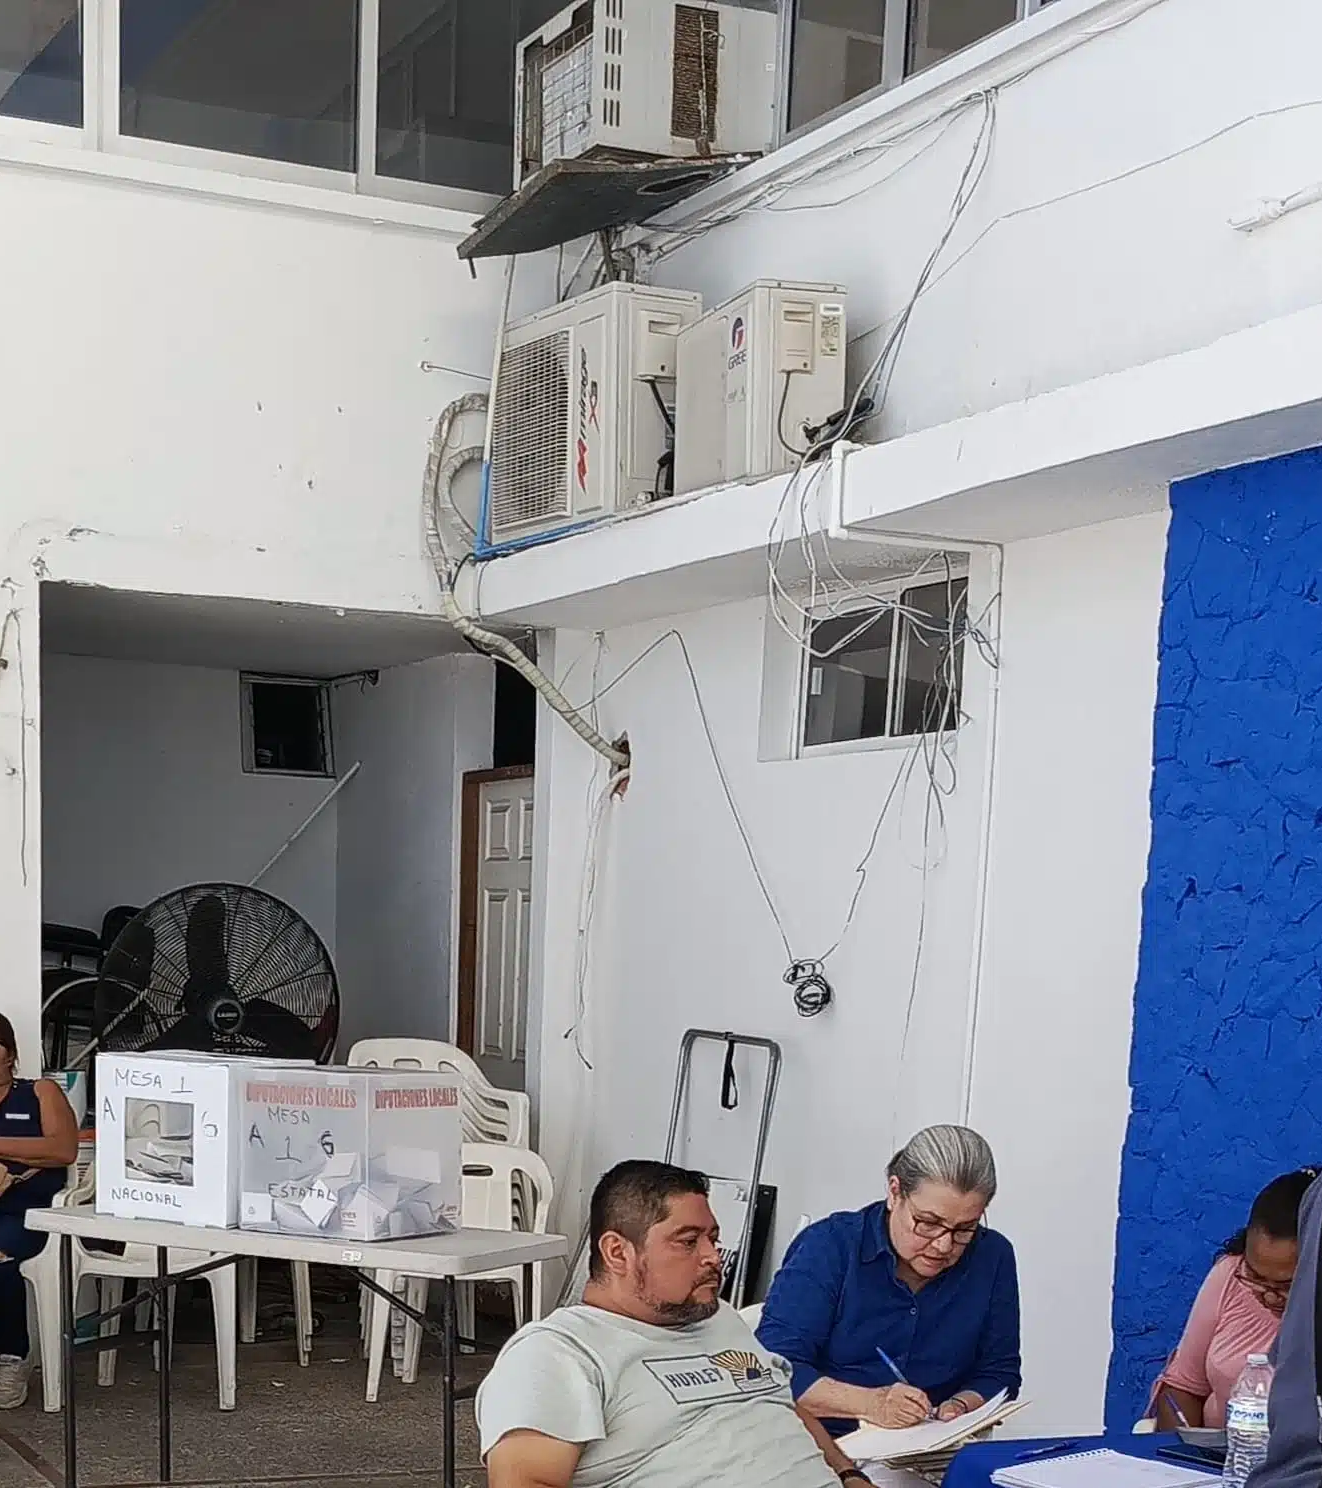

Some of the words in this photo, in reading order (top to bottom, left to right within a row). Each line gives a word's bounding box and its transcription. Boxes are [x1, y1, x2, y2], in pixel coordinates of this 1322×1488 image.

[727, 349, 749, 370] GREE
[114, 1067, 163, 1089] MESA
[170, 1076, 194, 1094] 1
[245, 1081, 314, 1105] DIPUTACIONES
[315, 1086, 358, 1109] LOCALES
[374, 1088, 428, 1110] DIPUTACIONES
[428, 1086, 459, 1109] LOCALES
[102, 1095, 116, 1123] A
[267, 1105, 311, 1125] MESA
[248, 1122, 265, 1148] A
[275, 1135, 303, 1163] 1
[111, 1187, 182, 1208] NACIONAL
[268, 1182, 339, 1202] ESTATAL
[663, 1366, 725, 1389] HURLEY
